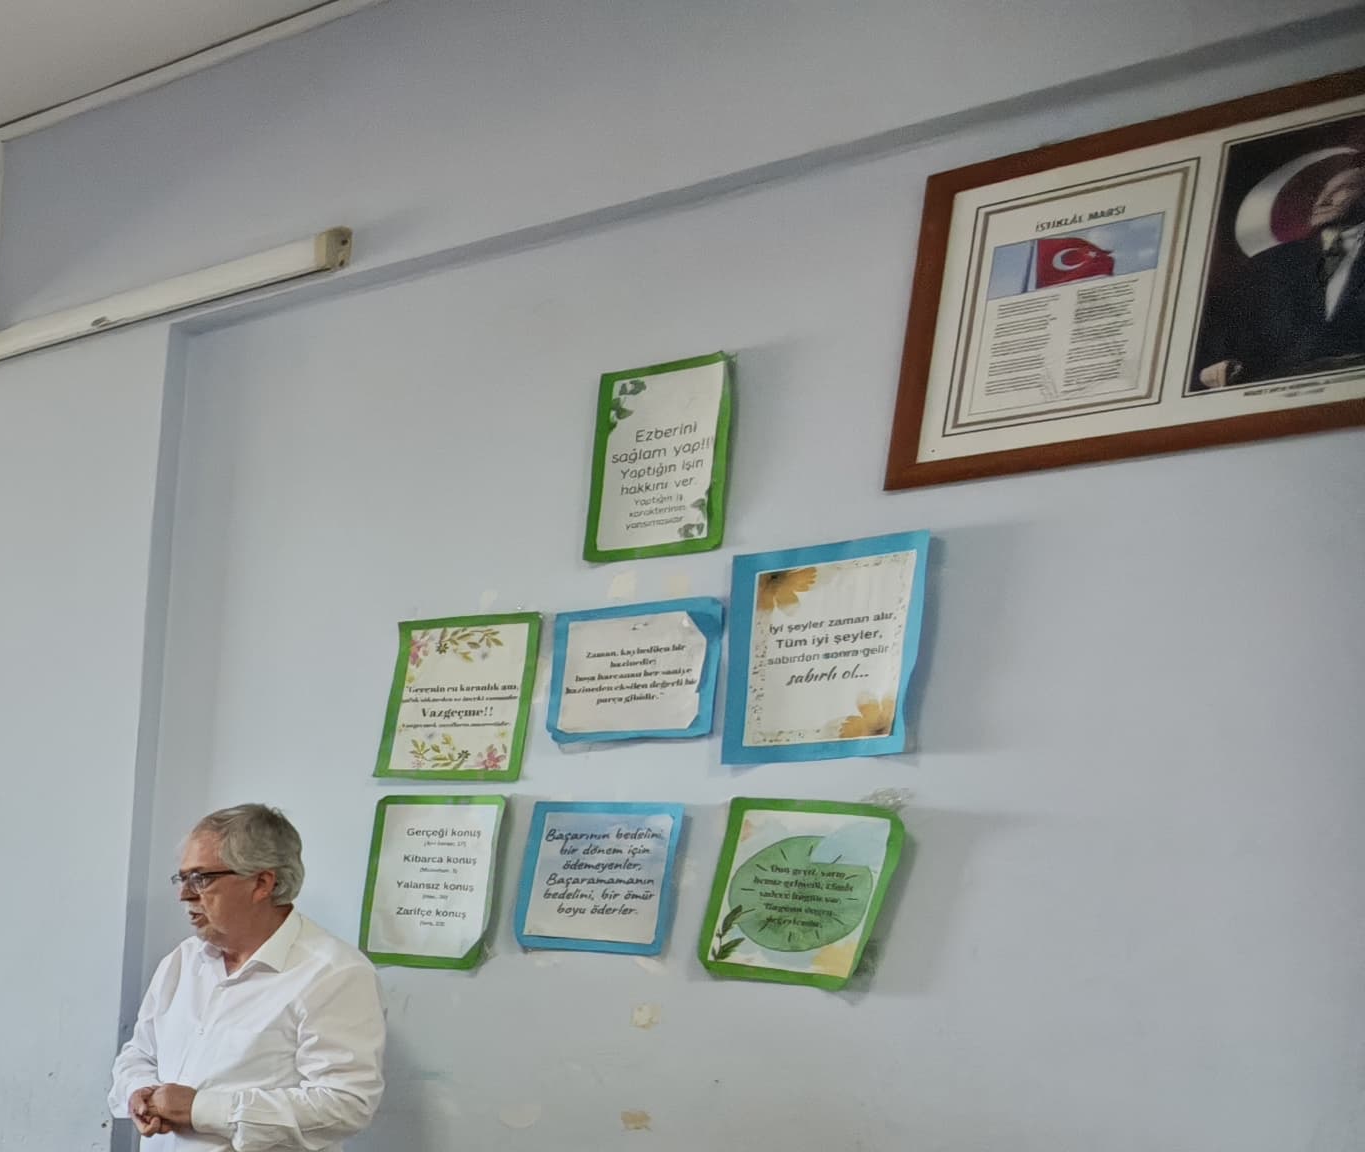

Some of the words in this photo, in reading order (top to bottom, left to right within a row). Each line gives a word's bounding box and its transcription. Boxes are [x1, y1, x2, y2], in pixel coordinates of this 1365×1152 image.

[635, 421, 697, 443] Ezberini
[612, 448, 666, 464] sağlam
[621, 463, 676, 480] Yaptığın
[682, 459, 704, 471] işin
[621, 482, 668, 496] hakkını
[787, 620, 824, 633] şeyler
[828, 615, 870, 627] zaman
[776, 636, 807, 649] Tüm
[812, 634, 829, 647] iyi
[767, 650, 820, 666] sabırdan
[786, 666, 837, 686] sabırlı
[421, 706, 494, 719] Vazgeçme!!
[406, 828, 449, 839] Gerçeği
[451, 828, 482, 839] konuş
[560, 844, 579, 856] bir
[583, 844, 623, 856] dönem
[627, 844, 650, 857] için
[403, 854, 443, 864] Kibarca
[446, 855, 477, 865] konuş
[396, 880, 440, 890] Yalansız
[443, 880, 474, 892] konuş
[601, 889, 621, 900] bir
[624, 889, 656, 901] ömür
[396, 907, 432, 918] Zarifçe
[435, 907, 467, 919] konuş
[557, 904, 586, 918] boyu
